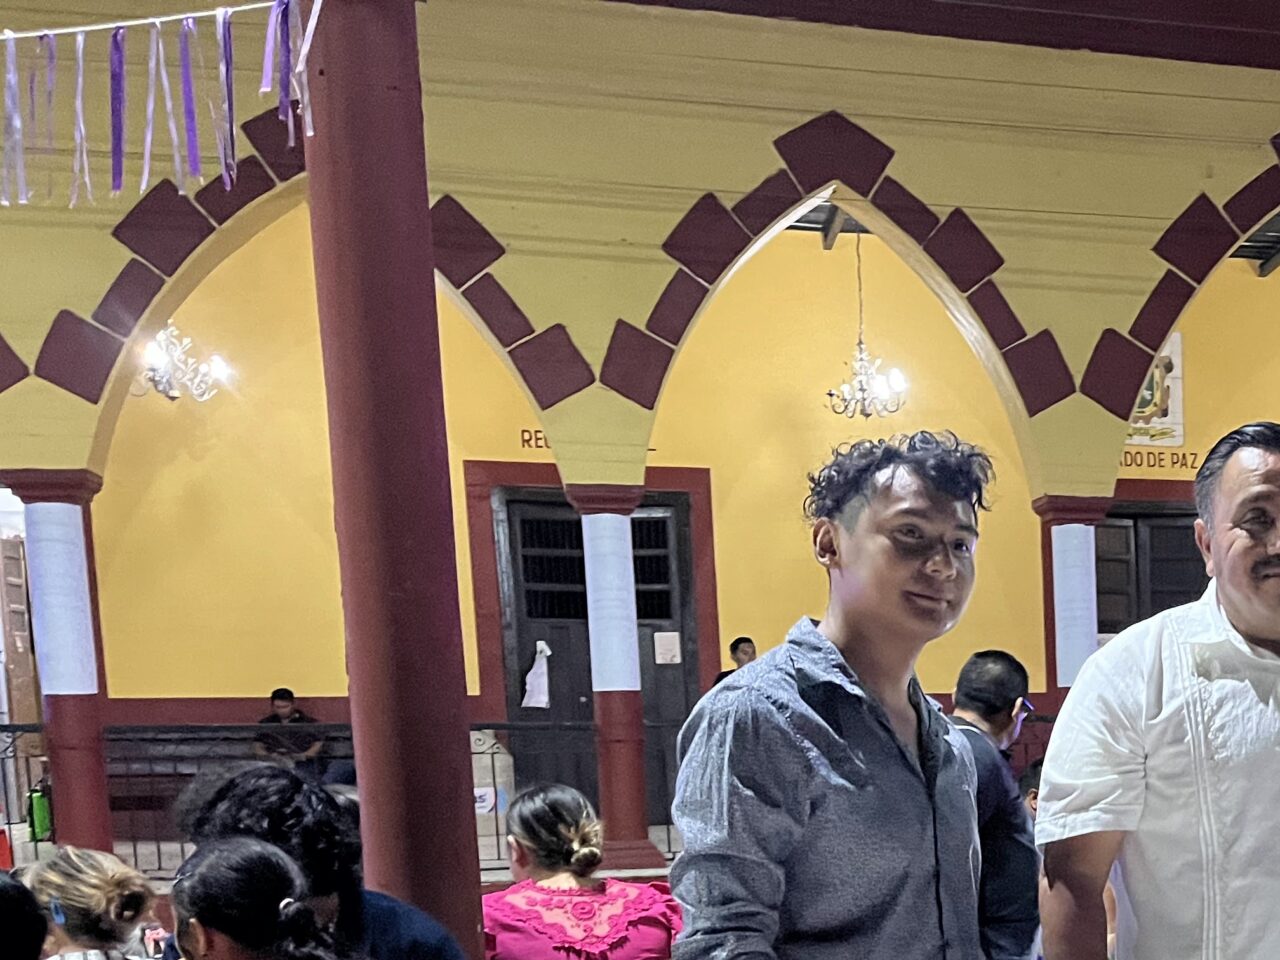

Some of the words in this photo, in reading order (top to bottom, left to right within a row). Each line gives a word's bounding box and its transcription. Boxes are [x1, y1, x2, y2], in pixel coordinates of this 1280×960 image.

[1119, 451, 1143, 467] DO
[1147, 452, 1165, 468] DE
[1171, 453, 1198, 469] PAZ
